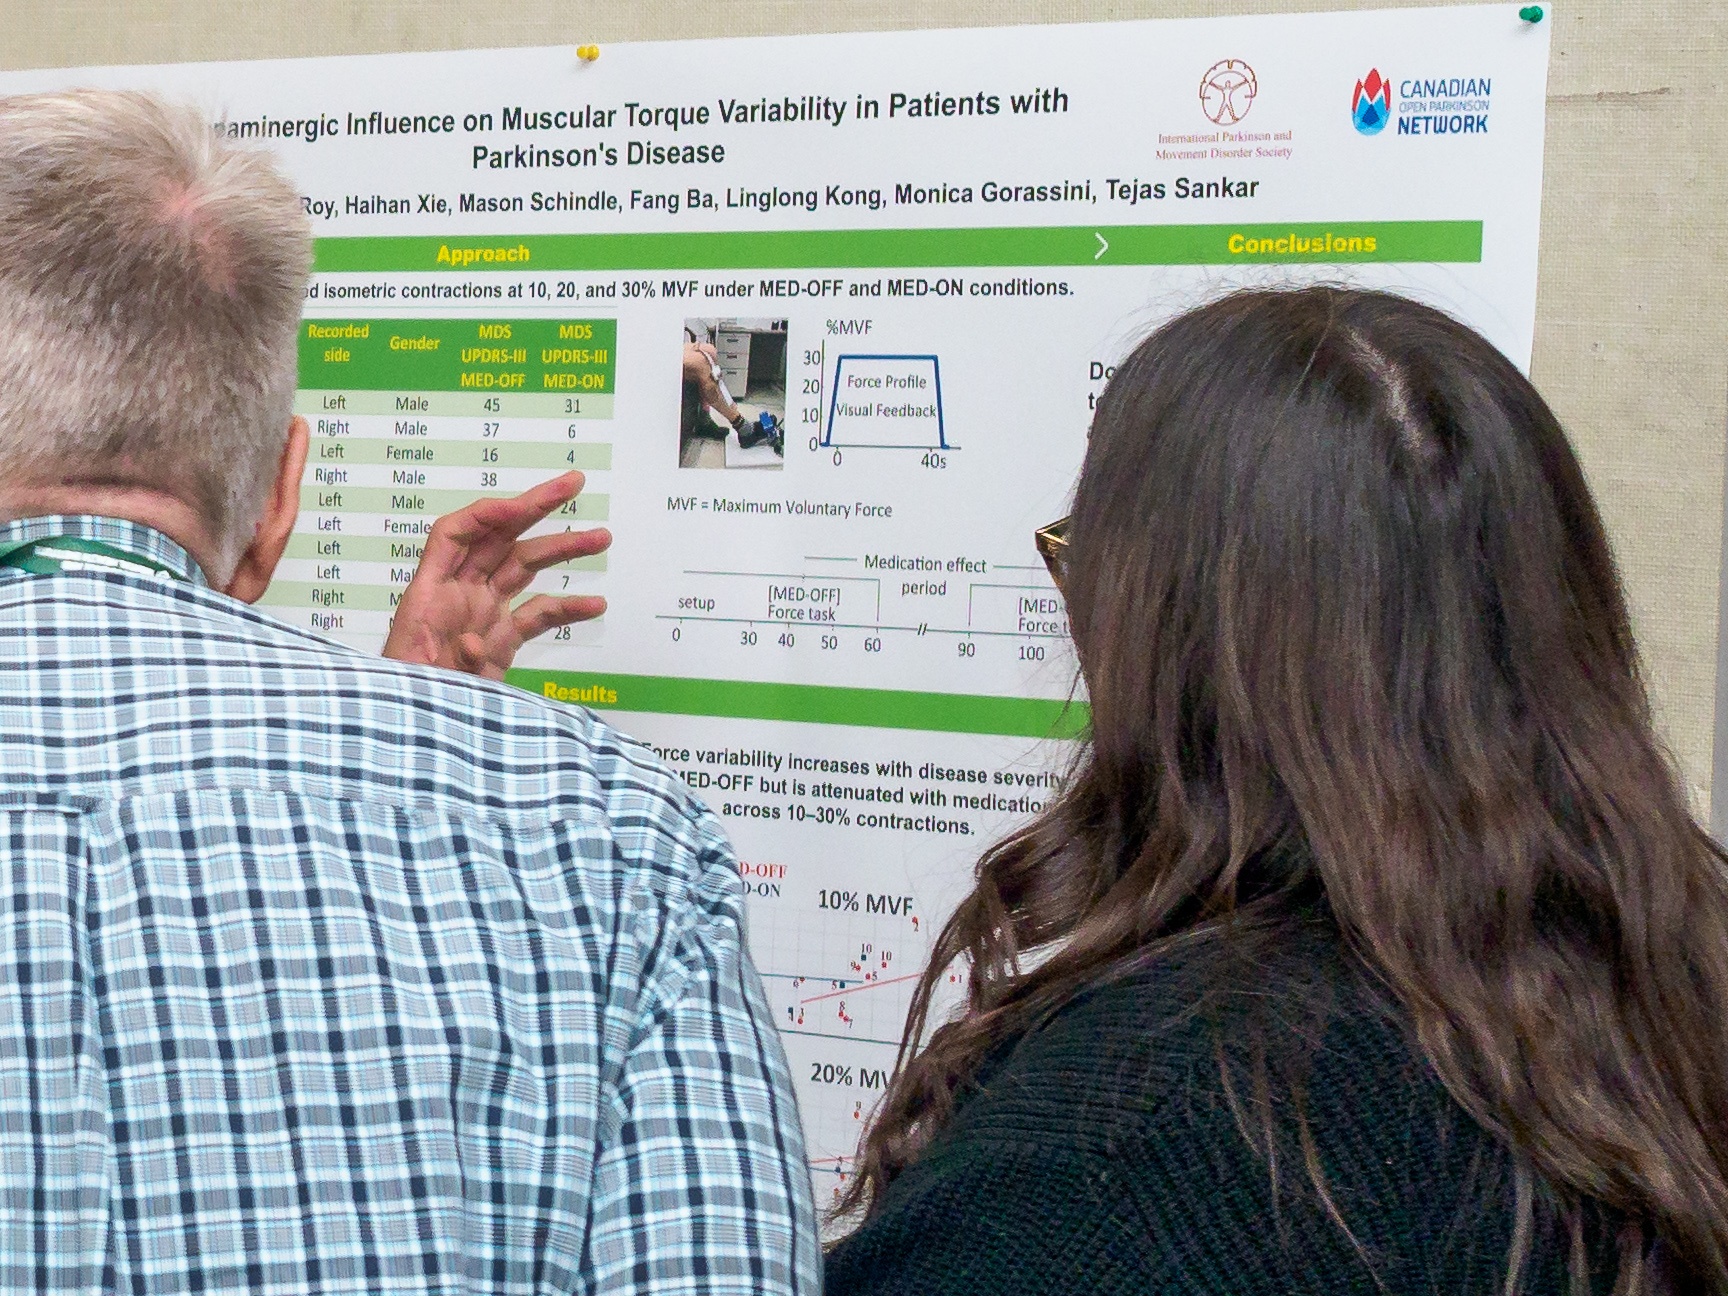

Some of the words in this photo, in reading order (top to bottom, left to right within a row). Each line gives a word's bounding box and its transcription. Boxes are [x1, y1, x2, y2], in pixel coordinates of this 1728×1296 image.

[1400, 78, 1490, 99] CANADIAN
[347, 111, 455, 135] Influence
[463, 113, 493, 132] on
[502, 105, 617, 131] Muscular
[624, 102, 710, 131] Torque
[718, 95, 846, 126] Variability
[856, 94, 879, 119] in
[889, 91, 1000, 118] Patients
[1010, 87, 1069, 114] with
[1397, 114, 1488, 135] NETWORK
[1158, 132, 1219, 145] International
[1223, 131, 1271, 143] Parkinson
[1274, 130, 1292, 142] and
[472, 142, 619, 169] Parkinson's
[627, 140, 726, 165] Disease
[1155, 148, 1207, 160] Movement
[1210, 147, 1252, 159] Disorder
[1255, 146, 1292, 160] Society
[345, 194, 410, 215] Haihan
[417, 194, 452, 216] Xie,
[459, 193, 523, 212] Mason
[530, 191, 623, 214] Schindle,
[630, 189, 679, 214] Fang
[687, 188, 719, 212] Ba,
[726, 185, 818, 212] Linglong
[826, 185, 887, 210] Kong,
[894, 183, 973, 205] Monica
[981, 180, 1098, 205] Gorassini,
[1106, 177, 1166, 205] Tejas
[1174, 177, 1260, 199] Sankar
[1227, 233, 1377, 254] Conclusions
[437, 245, 530, 267] Approach
[324, 282, 396, 299] isometric
[401, 282, 502, 299] contractions
[507, 282, 523, 298] at
[528, 282, 551, 300] 10,
[556, 281, 580, 300] 20,
[585, 281, 616, 298] and
[622, 281, 656, 298] 30%
[662, 280, 698, 298] MVF
[704, 280, 754, 298] under
[759, 279, 844, 298] MED-OFF
[849, 279, 881, 297] and
[887, 278, 964, 297] MED-ON
[969, 278, 1075, 297] conditions.
[826, 319, 873, 335] %MVF
[308, 323, 369, 339] Recorded
[390, 336, 440, 351] Gender
[479, 324, 511, 340] MDS
[559, 324, 593, 340] MDS
[324, 349, 350, 363] side
[461, 349, 527, 364] UPDRS-III
[541, 349, 608, 364] UPDRS-III
[803, 350, 820, 366] 30
[460, 373, 526, 388] MED-OFF
[543, 374, 605, 389] MED-ON
[802, 379, 820, 394] 20
[847, 375, 881, 389] Force
[885, 375, 927, 390] Profile
[322, 396, 346, 410] Left
[395, 397, 429, 412] Male
[483, 398, 500, 413] 45
[564, 399, 581, 414] 31
[836, 403, 873, 417] Visual
[876, 403, 936, 418] Feedback
[801, 408, 819, 423] 10
[317, 420, 350, 437] Right
[394, 421, 428, 436] Male
[482, 423, 500, 438] 37
[567, 424, 576, 439] 6
[320, 444, 345, 459] Left
[386, 446, 434, 461] Female
[482, 447, 499, 462] 16
[566, 449, 575, 464] 4
[809, 437, 818, 452] 0
[832, 451, 842, 467] 0
[921, 453, 947, 469] 40s
[315, 468, 348, 484] Right
[392, 470, 426, 485] Male
[480, 472, 497, 487] 38
[318, 493, 342, 508] Left
[391, 495, 424, 510] Male
[560, 501, 577, 515] 24
[667, 496, 698, 511] MVF
[712, 498, 782, 514] Maximum
[786, 499, 851, 519] Voluntary
[854, 502, 893, 517] Force
[317, 517, 342, 532] Left
[384, 519, 431, 535] Female
[316, 540, 341, 555] Left
[864, 554, 943, 572] Medication
[946, 557, 987, 574] effect
[316, 565, 340, 580] Left
[562, 575, 570, 590] 7
[312, 589, 345, 606] Right
[768, 584, 841, 606] [MED-OFF]
[901, 580, 947, 597] period
[678, 596, 716, 612] setup
[767, 605, 805, 620] Force
[808, 606, 836, 622] task
[311, 613, 344, 629] Right
[554, 626, 571, 641] 28
[1018, 617, 1058, 633] Force
[671, 627, 681, 642] 0
[740, 631, 758, 647] 30
[777, 633, 795, 648] 40
[821, 635, 838, 651] 50
[864, 637, 882, 652] 60
[957, 642, 976, 658] 90
[1018, 645, 1045, 661] 100
[543, 680, 617, 704] Results
[696, 748, 783, 772] variability
[788, 752, 870, 775] increases
[875, 761, 913, 779] with
[918, 762, 987, 784] disease
[759, 775, 787, 795] but
[792, 778, 806, 796] is
[811, 781, 904, 804] attenuated
[909, 788, 947, 807] with
[722, 801, 781, 819] across
[856, 811, 976, 836] contractions.
[819, 889, 859, 912] 10%
[866, 893, 914, 917] MVF
[810, 1063, 853, 1087] 20%
